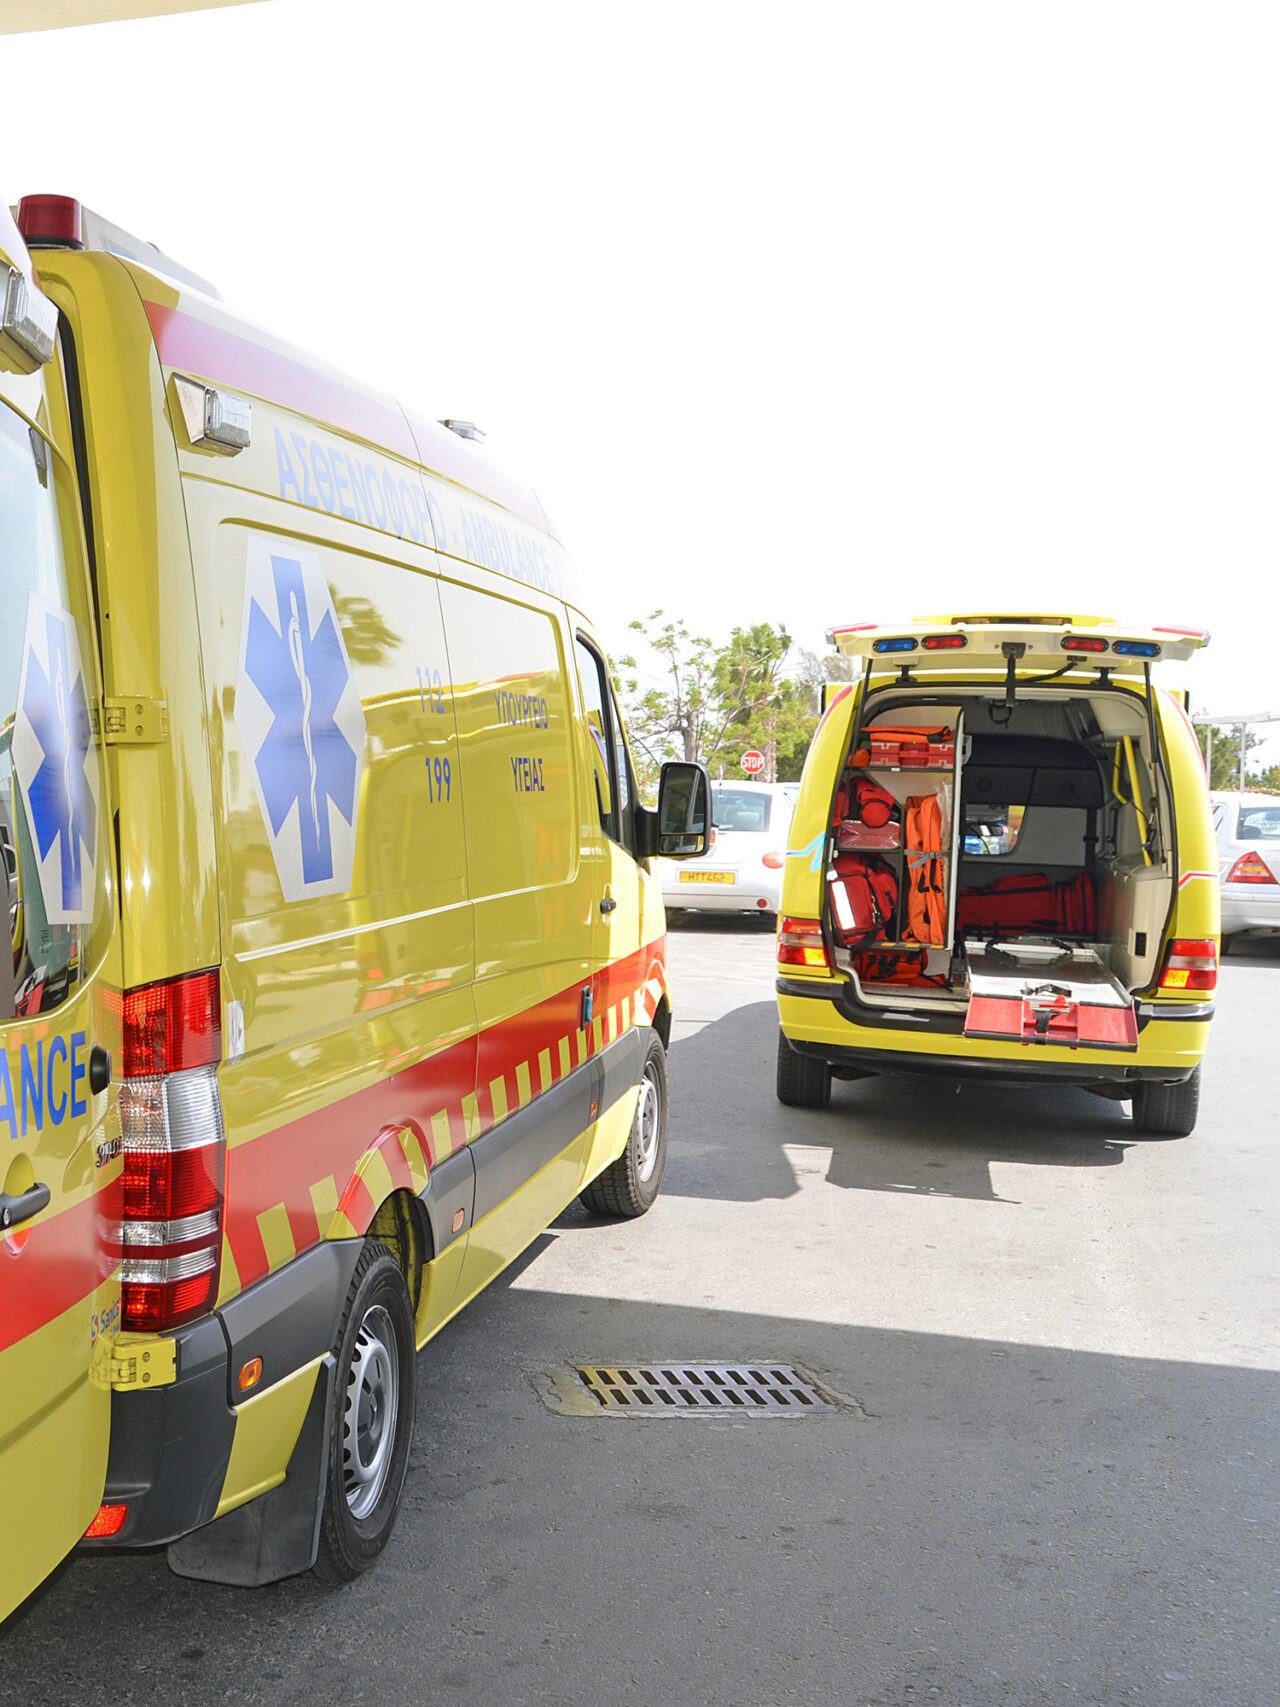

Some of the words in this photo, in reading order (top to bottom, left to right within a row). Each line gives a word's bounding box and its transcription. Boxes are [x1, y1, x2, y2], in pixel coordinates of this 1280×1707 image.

[274, 426, 447, 552] ΑΣΘΕΝΟΦΟΡΟ
[460, 506, 556, 594] AMBULANCE
[416, 667, 445, 714] 112
[494, 689, 549, 729] ΥΠΟΥΡΓΕΙΟ
[425, 757, 451, 804] 199
[510, 756, 545, 792] ΥΓΕΙΑΣ
[743, 756, 763, 769] STOP
